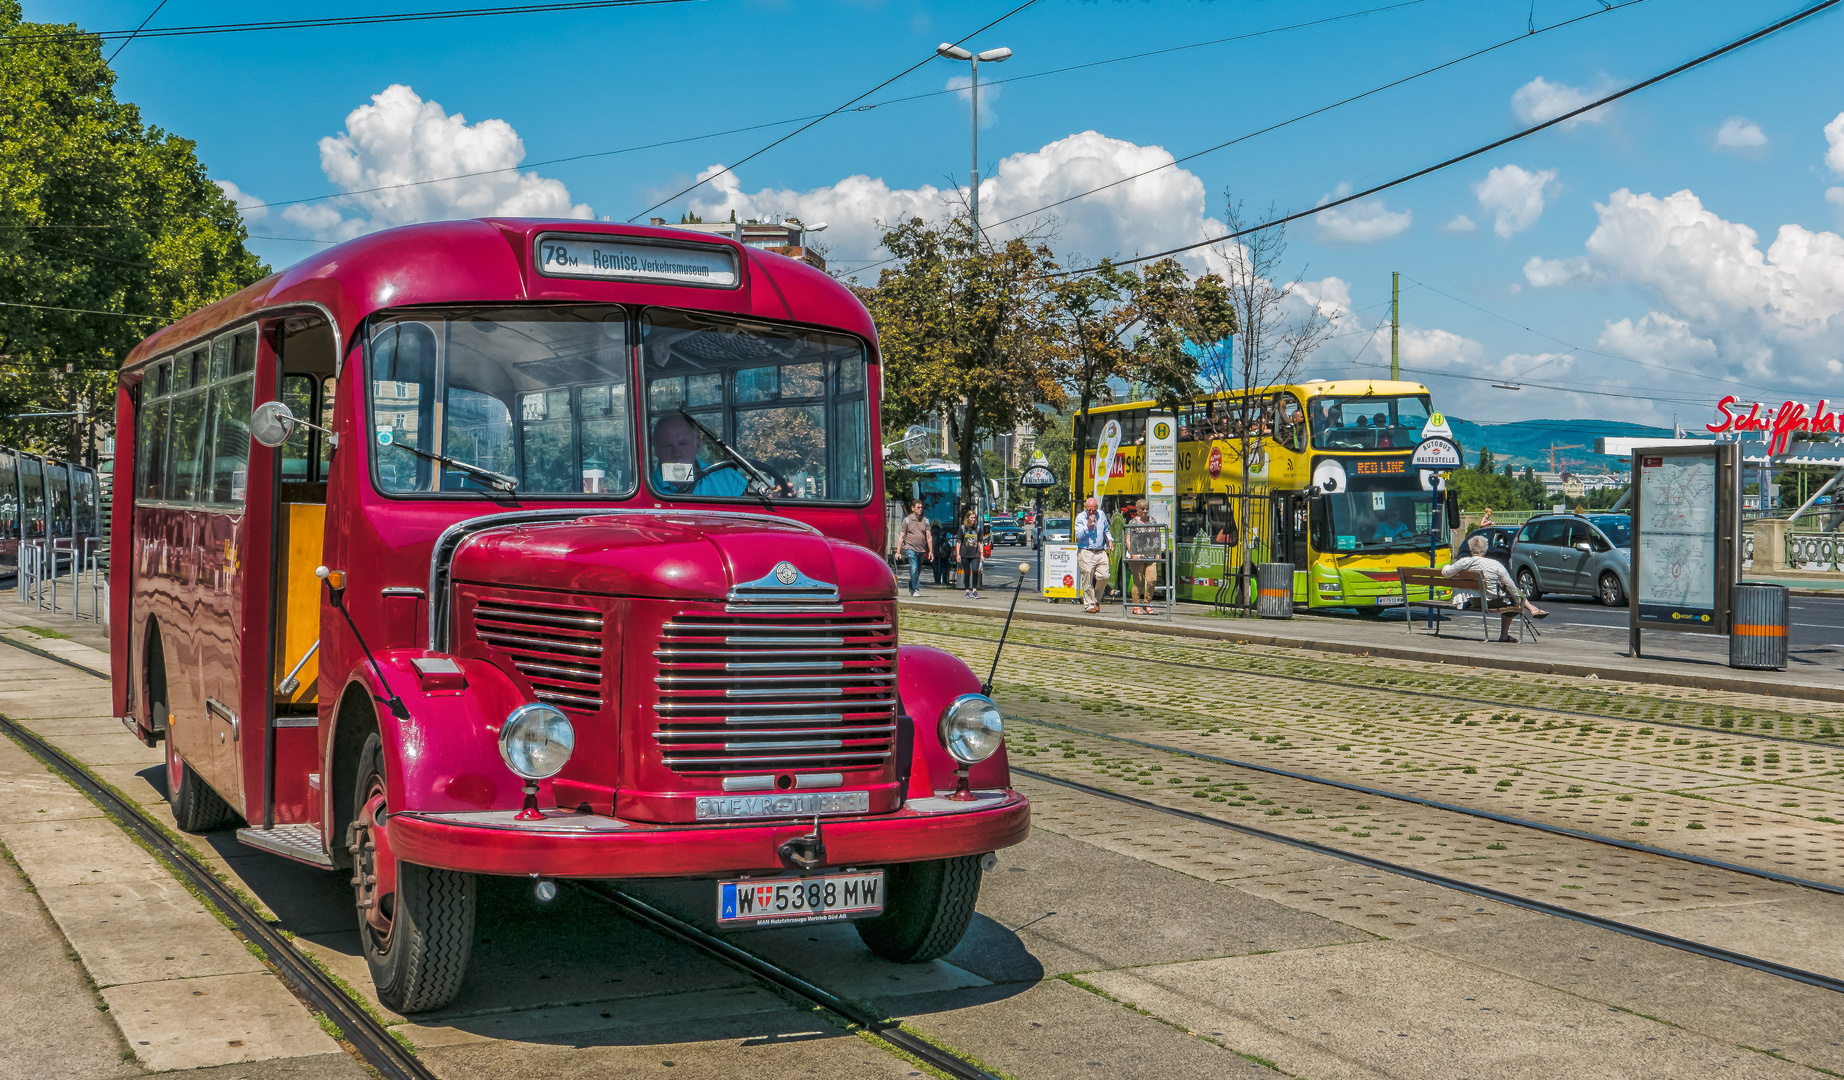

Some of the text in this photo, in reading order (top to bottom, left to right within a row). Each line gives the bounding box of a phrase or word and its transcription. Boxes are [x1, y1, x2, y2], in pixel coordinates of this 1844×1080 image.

[640, 258, 709, 277] Verkehrsmuseum
[1423, 441, 1451, 452] AUTOBUS
[1357, 461, 1405, 474] RED LINE
[1375, 497, 1383, 505] 11
[726, 879, 877, 914] A W 5388 MW
